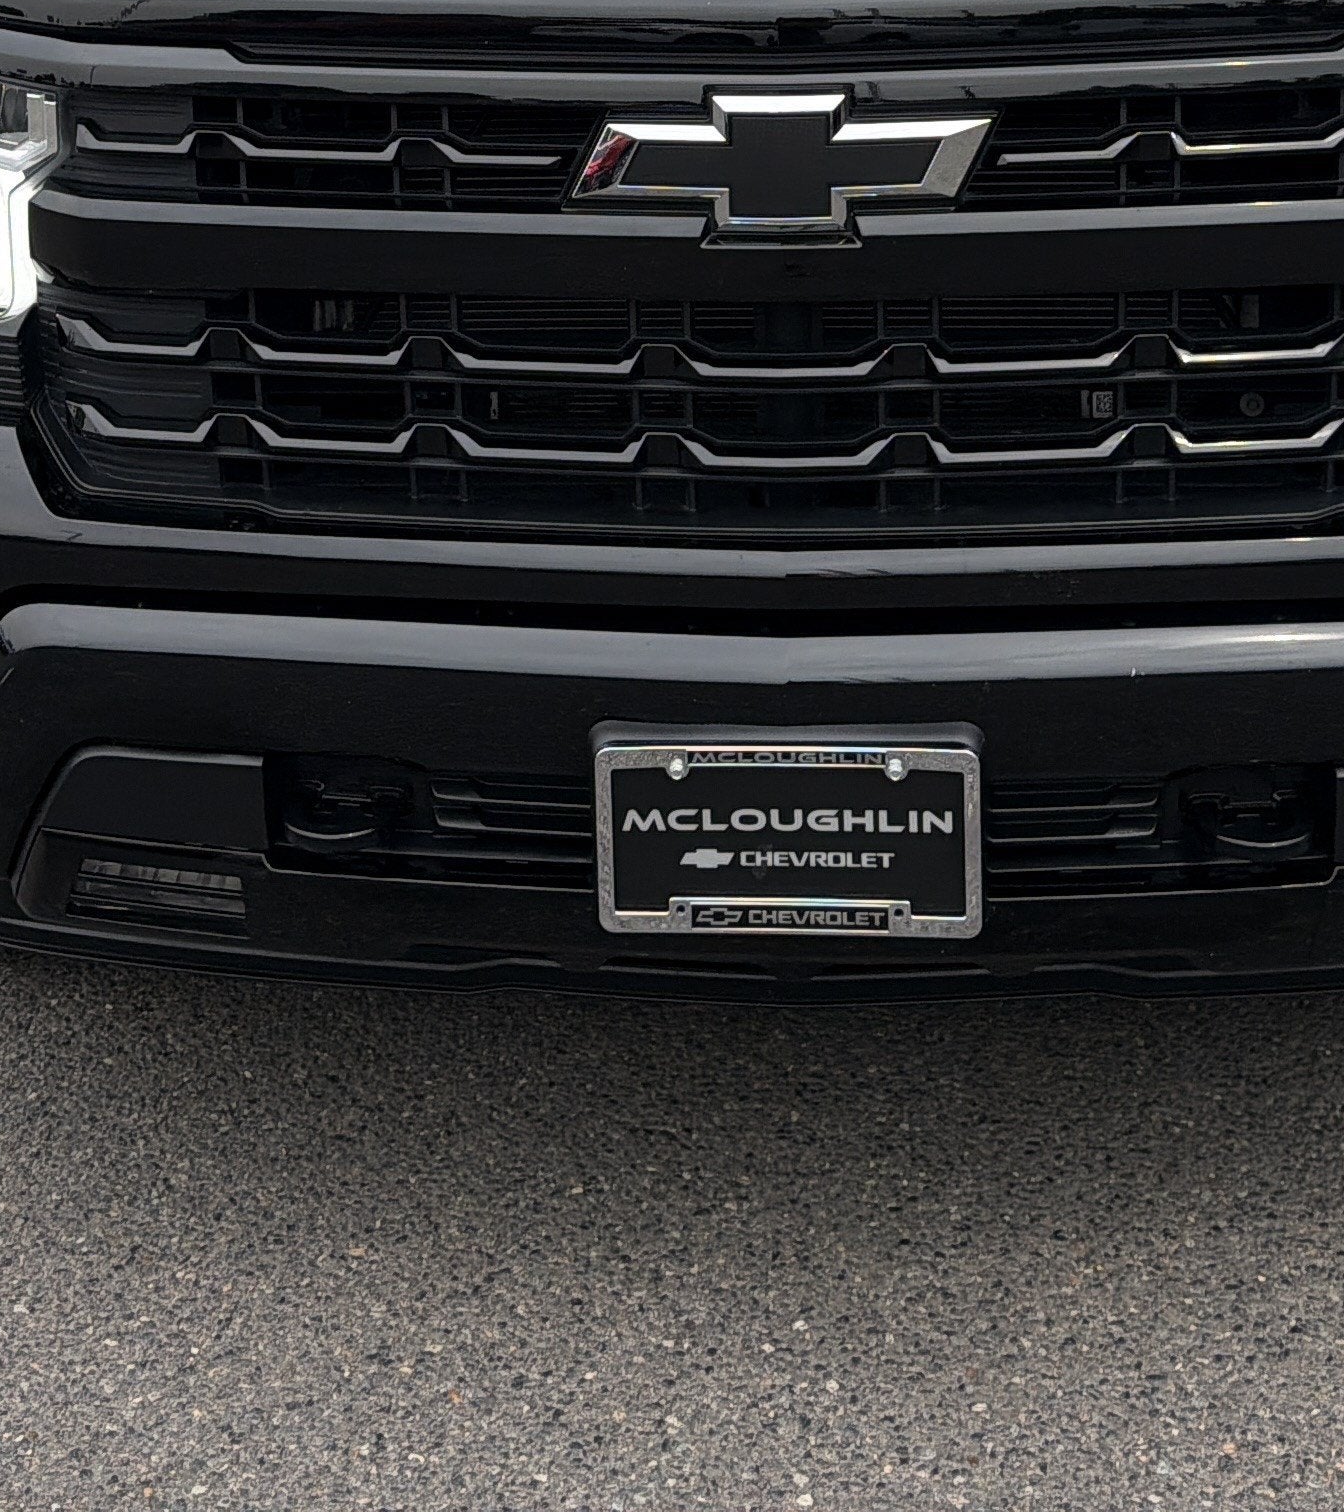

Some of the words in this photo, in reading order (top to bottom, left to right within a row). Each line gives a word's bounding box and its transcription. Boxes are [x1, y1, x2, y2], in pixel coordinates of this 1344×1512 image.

[691, 752, 883, 764] MCLOUGHLIN
[622, 808, 953, 834] MCLOUGHLIN
[739, 850, 895, 869] CHEVROLET
[748, 909, 885, 926] CHEVROLET
